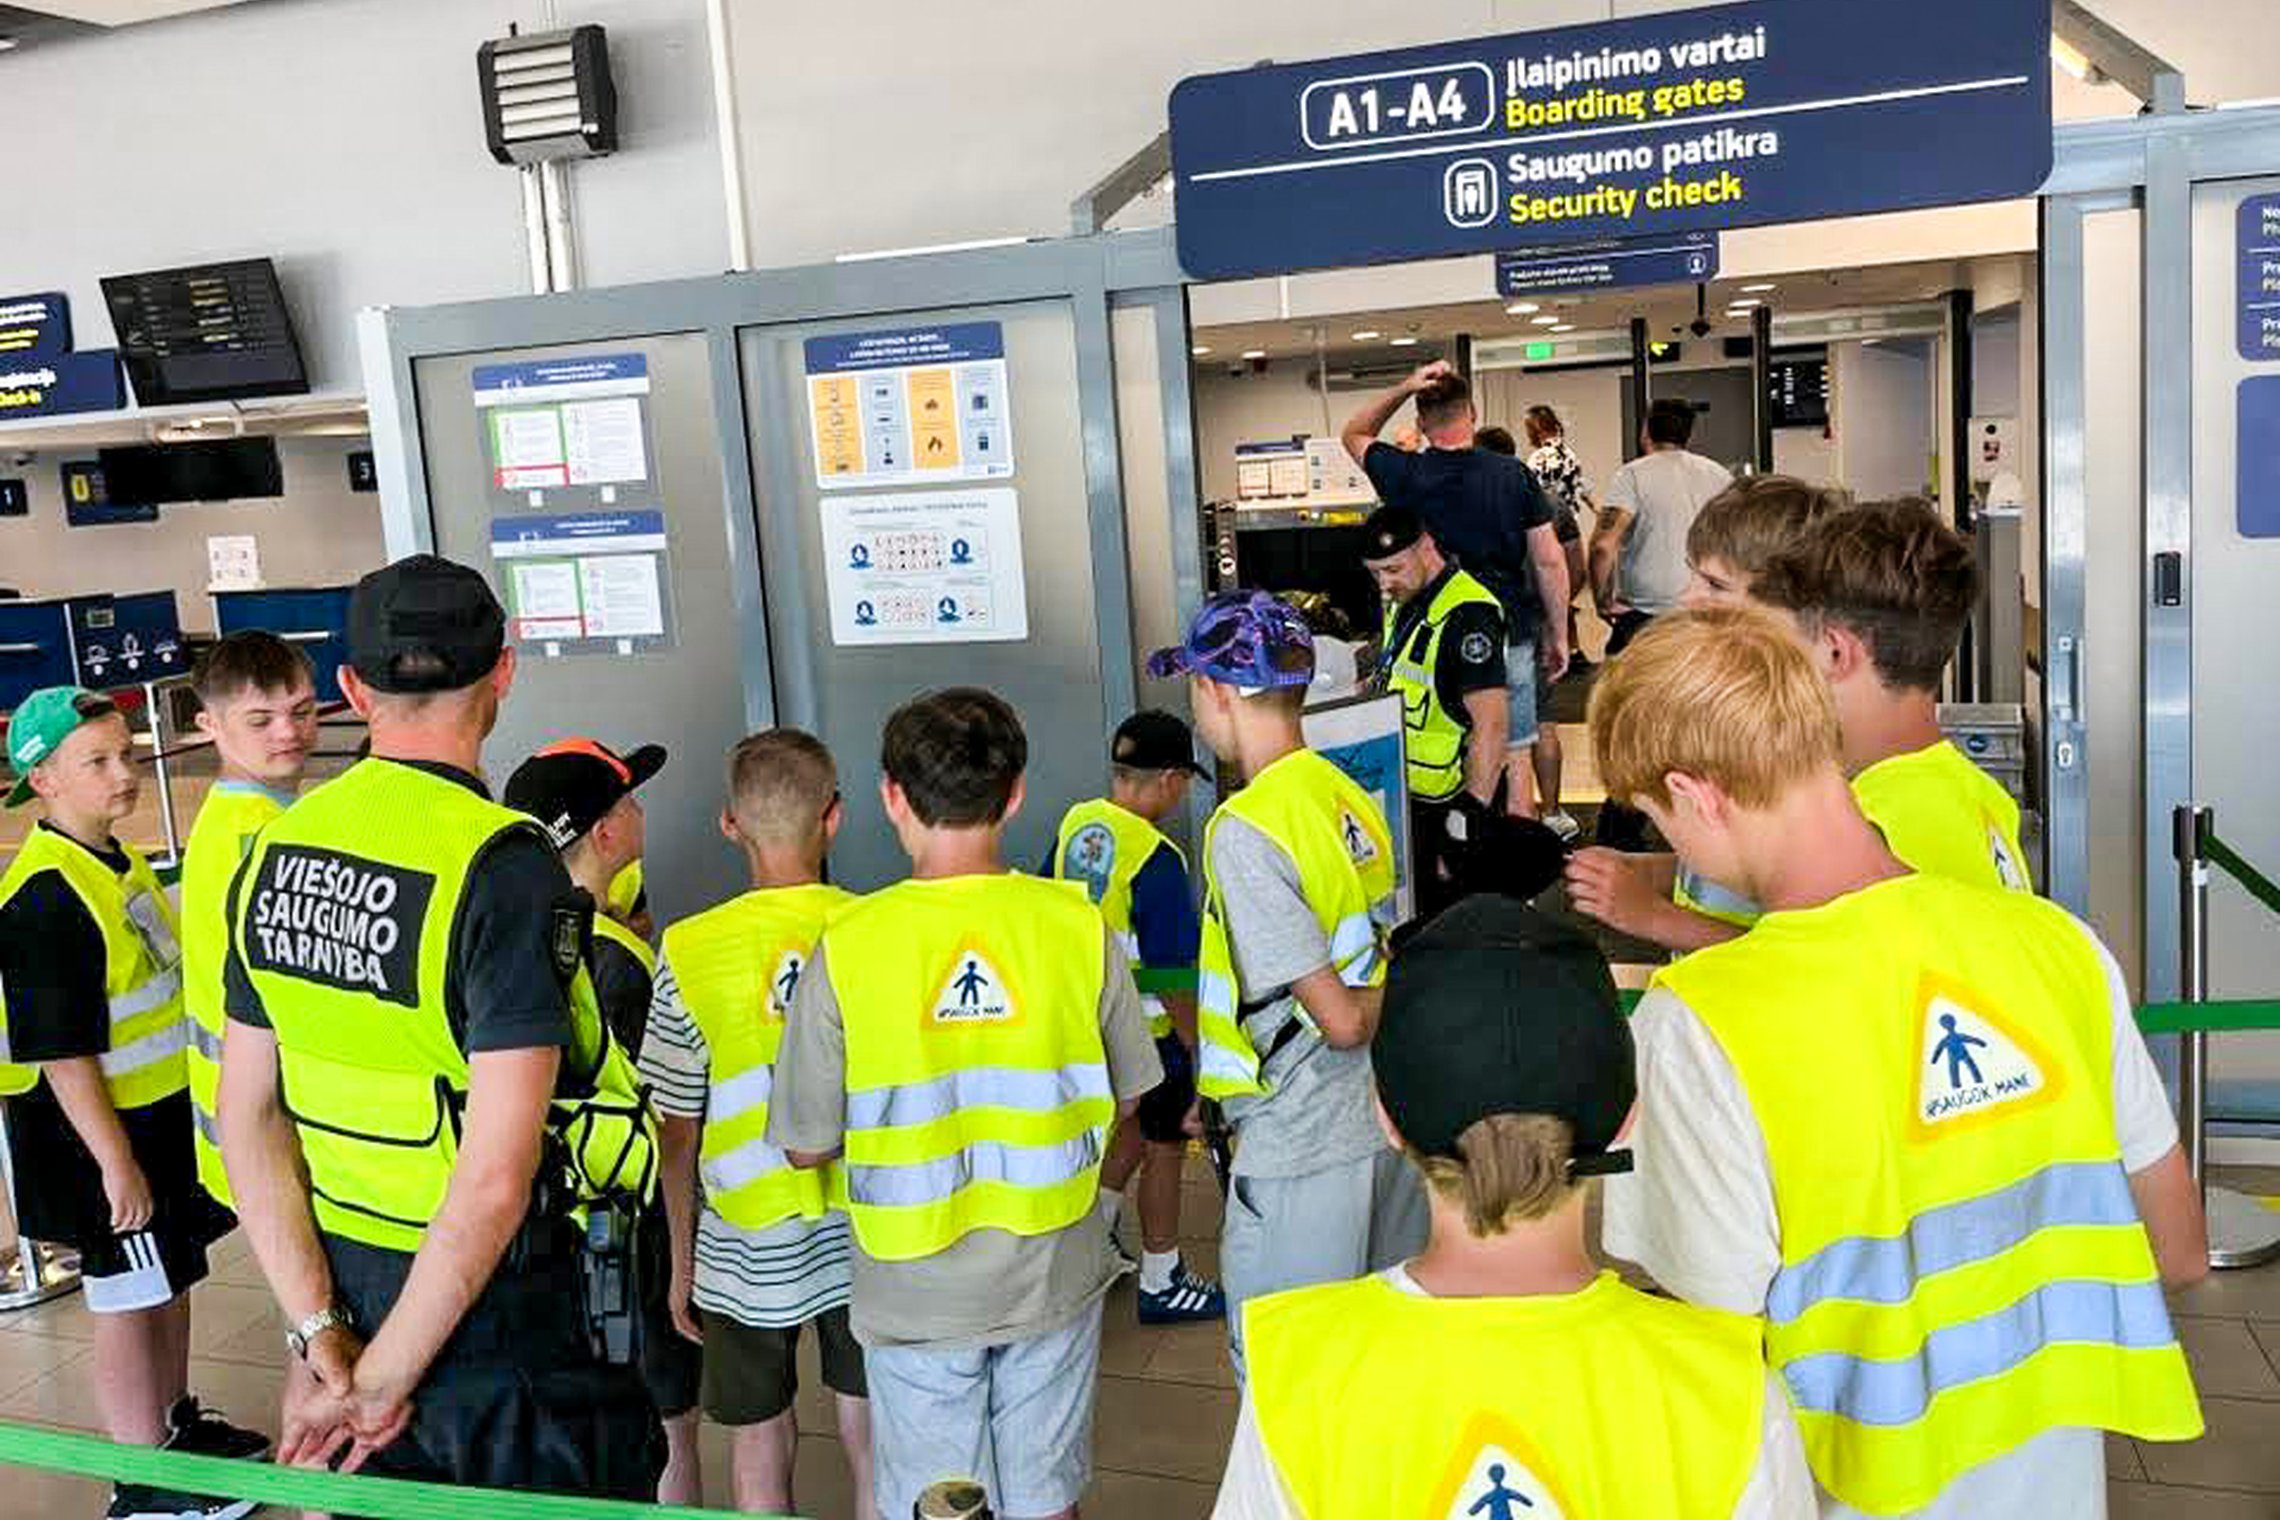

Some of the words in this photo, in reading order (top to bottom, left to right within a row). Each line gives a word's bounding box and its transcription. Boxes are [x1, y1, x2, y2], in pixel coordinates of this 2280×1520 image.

[1506, 46, 1662, 98] Įlaipinimo
[1669, 26, 1766, 69] vartai
[1328, 77, 1468, 137] A1-A4
[1506, 87, 1646, 128] Boarding
[1652, 78, 1745, 117] gates
[1508, 145, 1654, 185] Saugumo
[1662, 126, 1779, 175] patikra
[1509, 185, 1638, 224] Security
[1645, 169, 1742, 209] check
[274, 855, 397, 913] VIEŠOJO
[255, 890, 399, 954] SAUGUMO
[257, 926, 391, 991] TARNYBA
[1994, 1071, 2032, 1095] MANE
